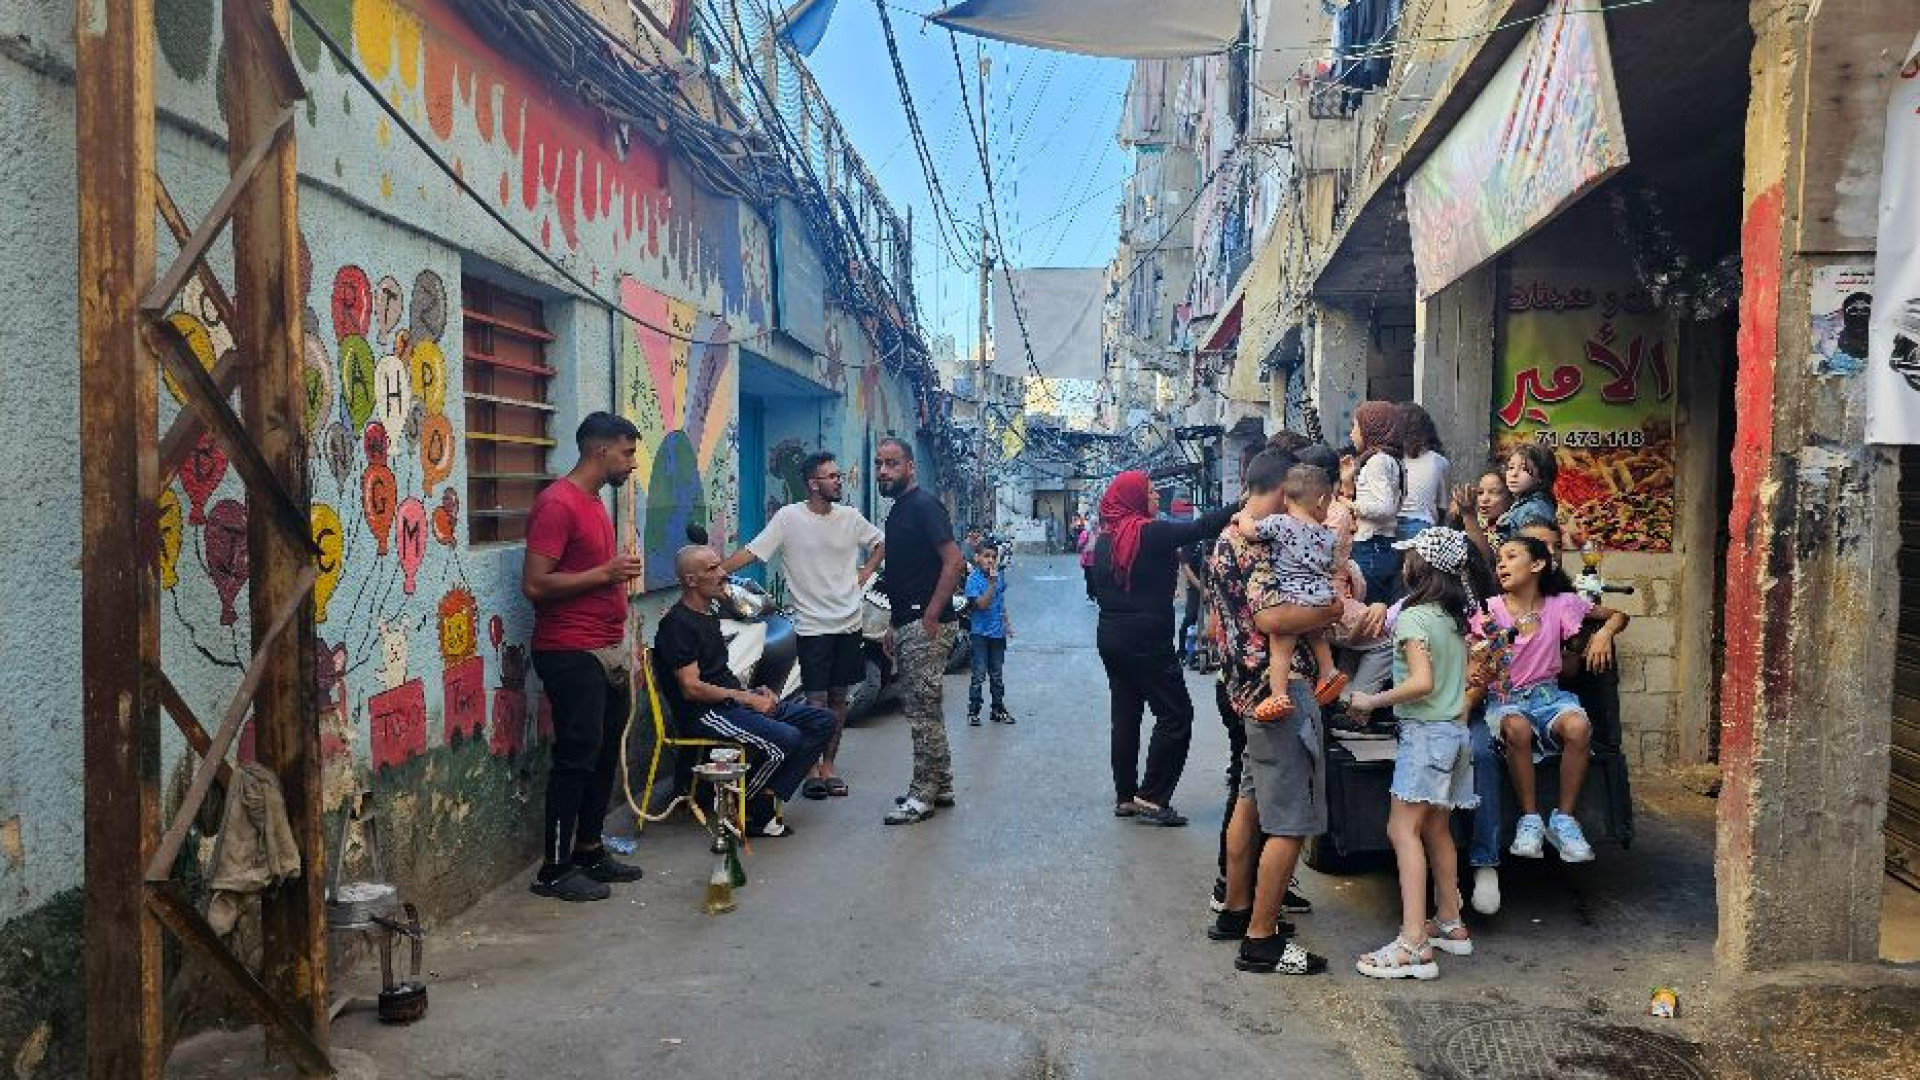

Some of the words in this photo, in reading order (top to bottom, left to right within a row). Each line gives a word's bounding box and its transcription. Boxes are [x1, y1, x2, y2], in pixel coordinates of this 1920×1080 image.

[385, 369, 402, 418] H
[1498, 322, 1673, 428] الأمير
[1536, 430, 1558, 447] 71
[1564, 430, 1601, 447] 473
[1607, 430, 1645, 447] 118
[402, 515, 420, 559] M
